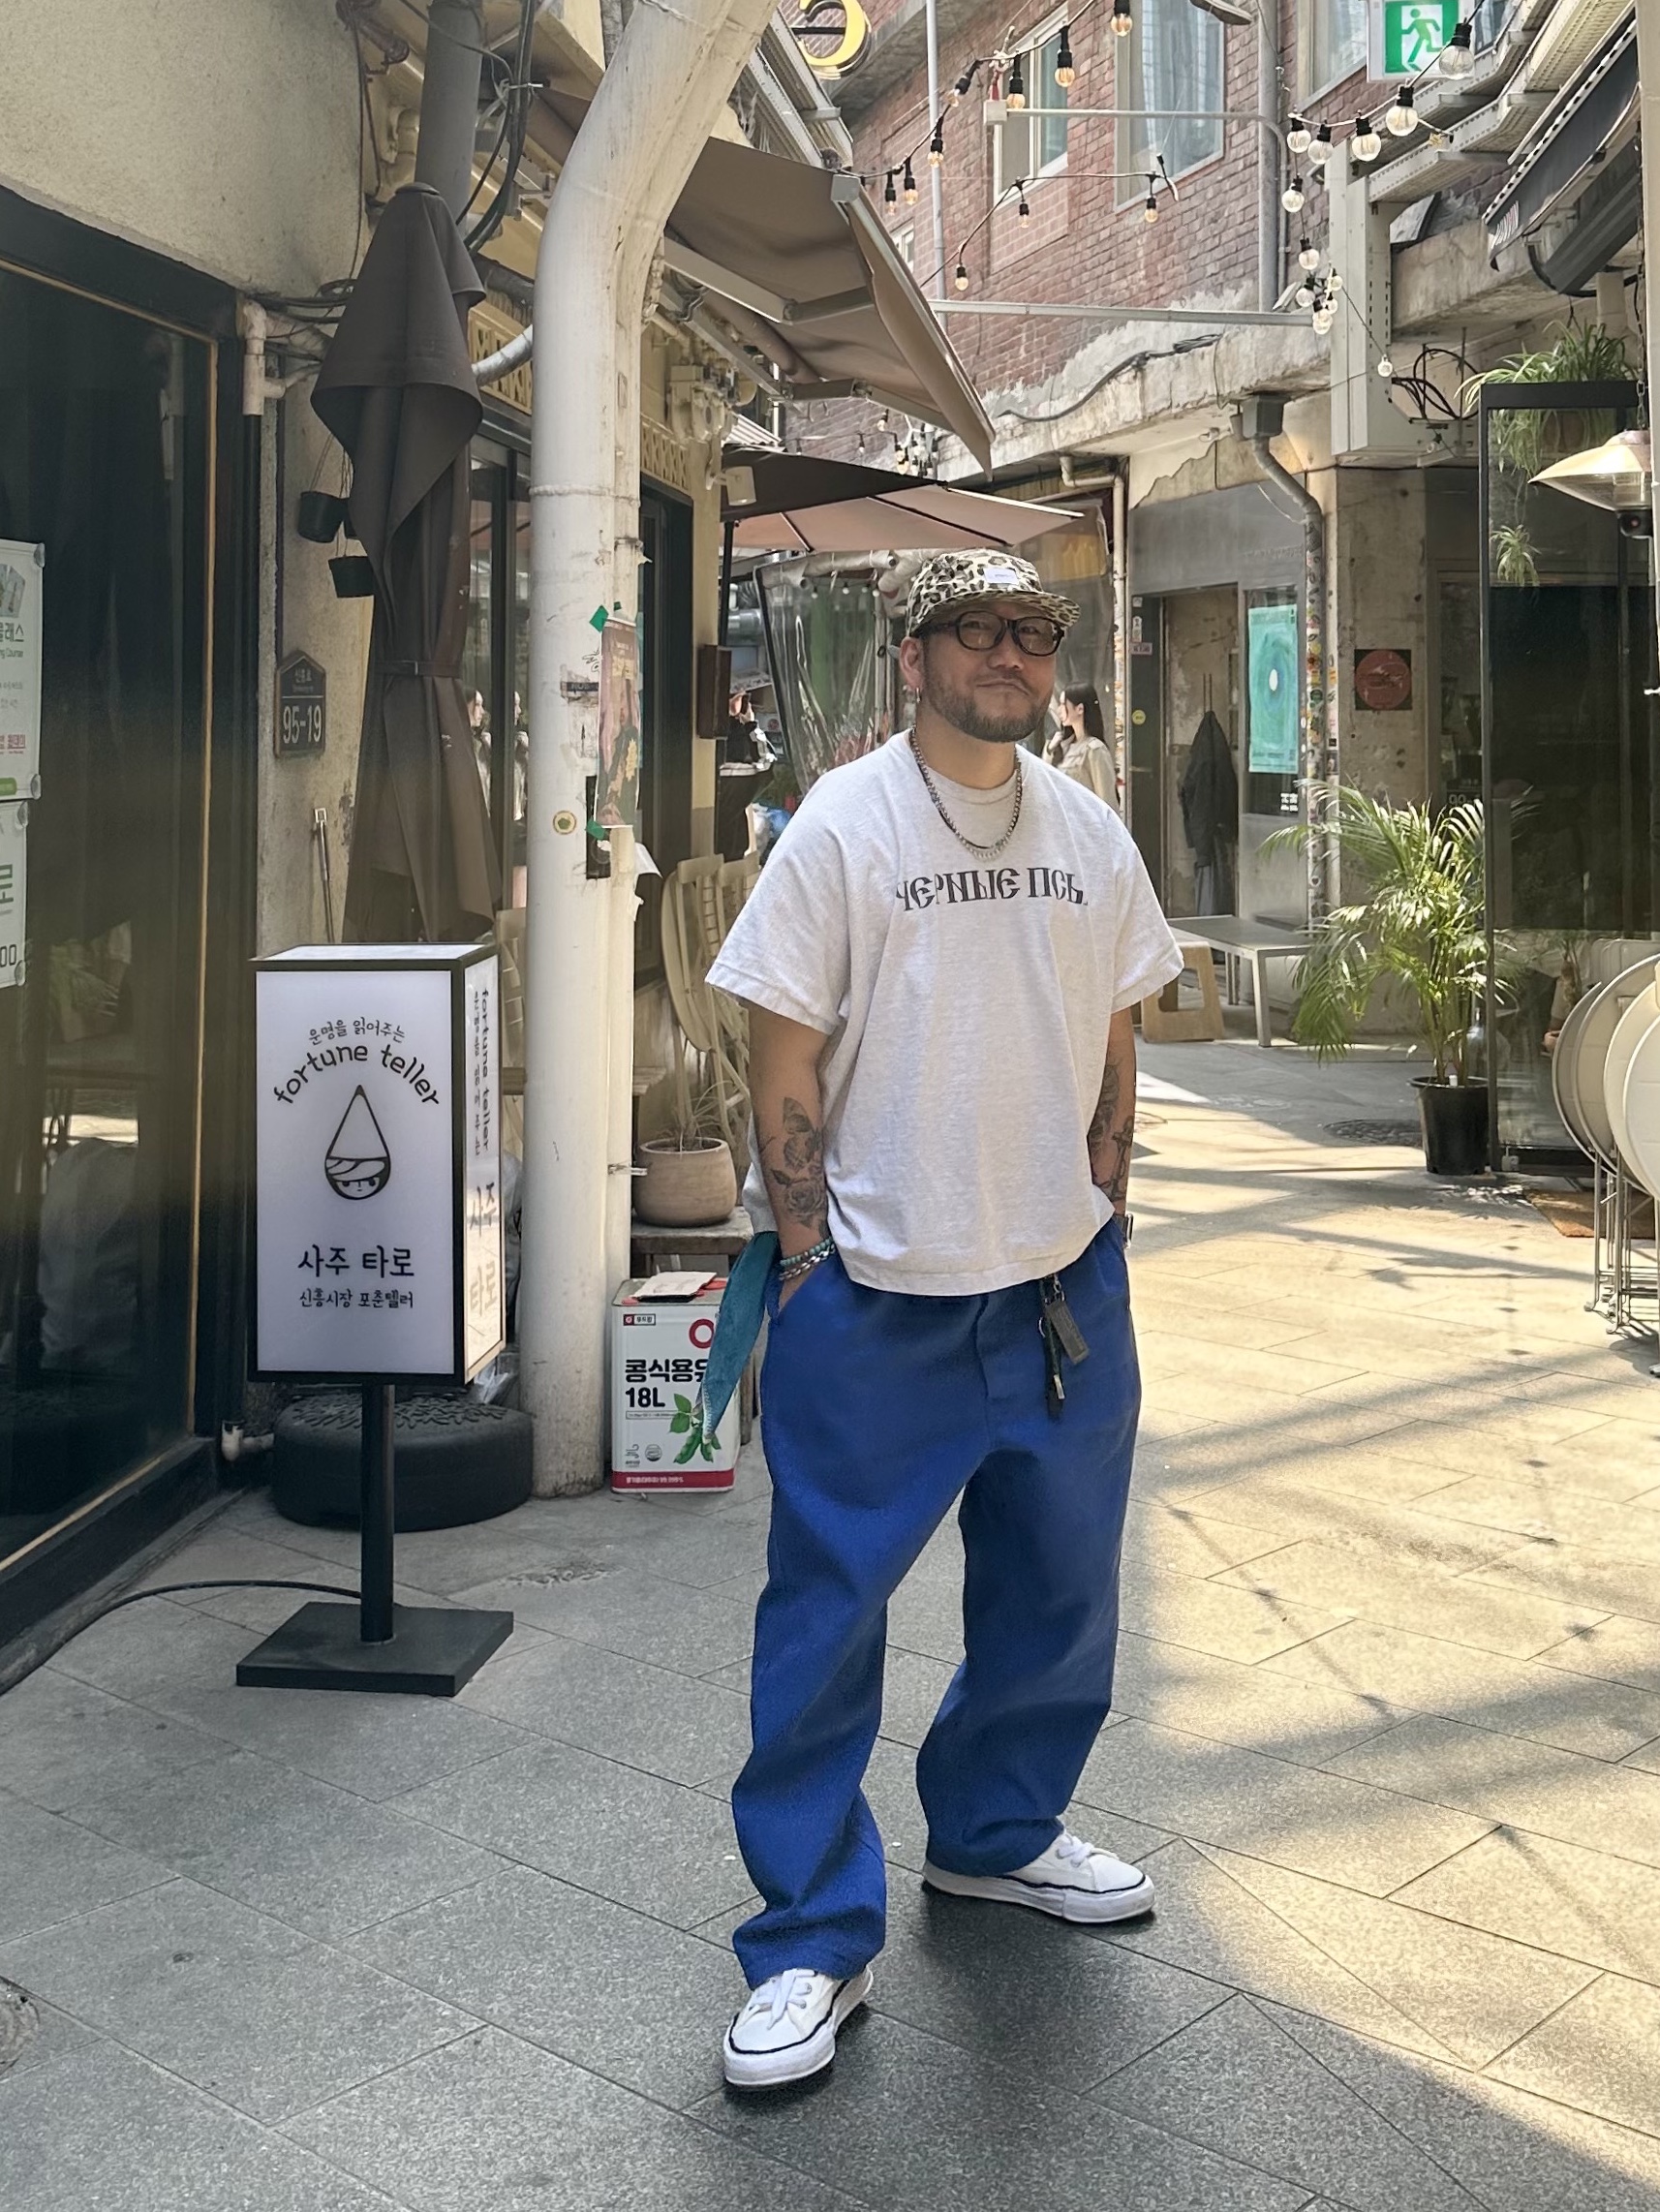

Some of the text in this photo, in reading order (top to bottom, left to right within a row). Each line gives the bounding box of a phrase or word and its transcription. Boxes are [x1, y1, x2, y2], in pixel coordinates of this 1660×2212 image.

[283, 704, 323, 744] 95-19
[308, 1016, 406, 1045] 운명을 읽어주는
[481, 987, 490, 1078] fortune
[273, 1044, 440, 1105] fortune teller
[470, 1181, 497, 1238] 사주
[297, 1244, 415, 1278] 사주 타로
[299, 1288, 414, 1308] 신흥시장 포춘텔러
[625, 1387, 665, 1407] 18L
